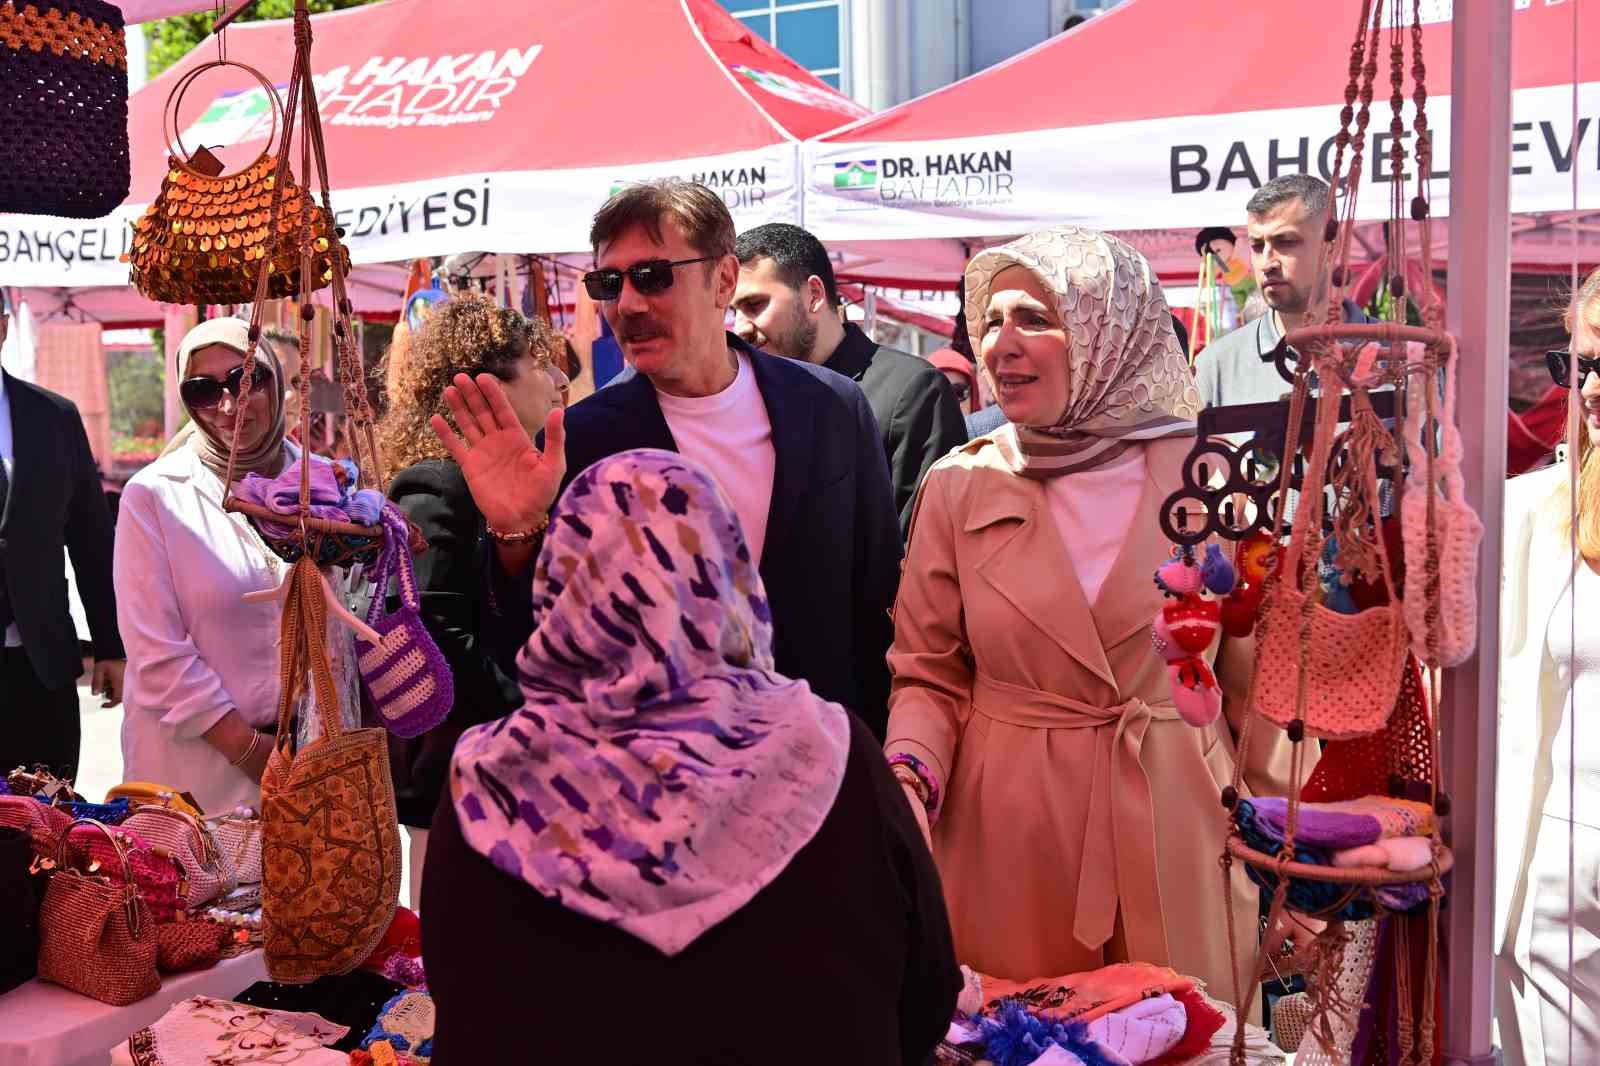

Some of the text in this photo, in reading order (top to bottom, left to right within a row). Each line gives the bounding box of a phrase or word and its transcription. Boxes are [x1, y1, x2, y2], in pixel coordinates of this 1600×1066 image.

[349, 44, 543, 86] HAKAN
[314, 77, 517, 114] HADIR
[882, 149, 1012, 178] DR. HAKAN
[1170, 116, 1600, 198] BAHÇELEV
[692, 166, 766, 188] HAKAN
[0, 177, 490, 272] BAHÇELİ EDİYESİ
